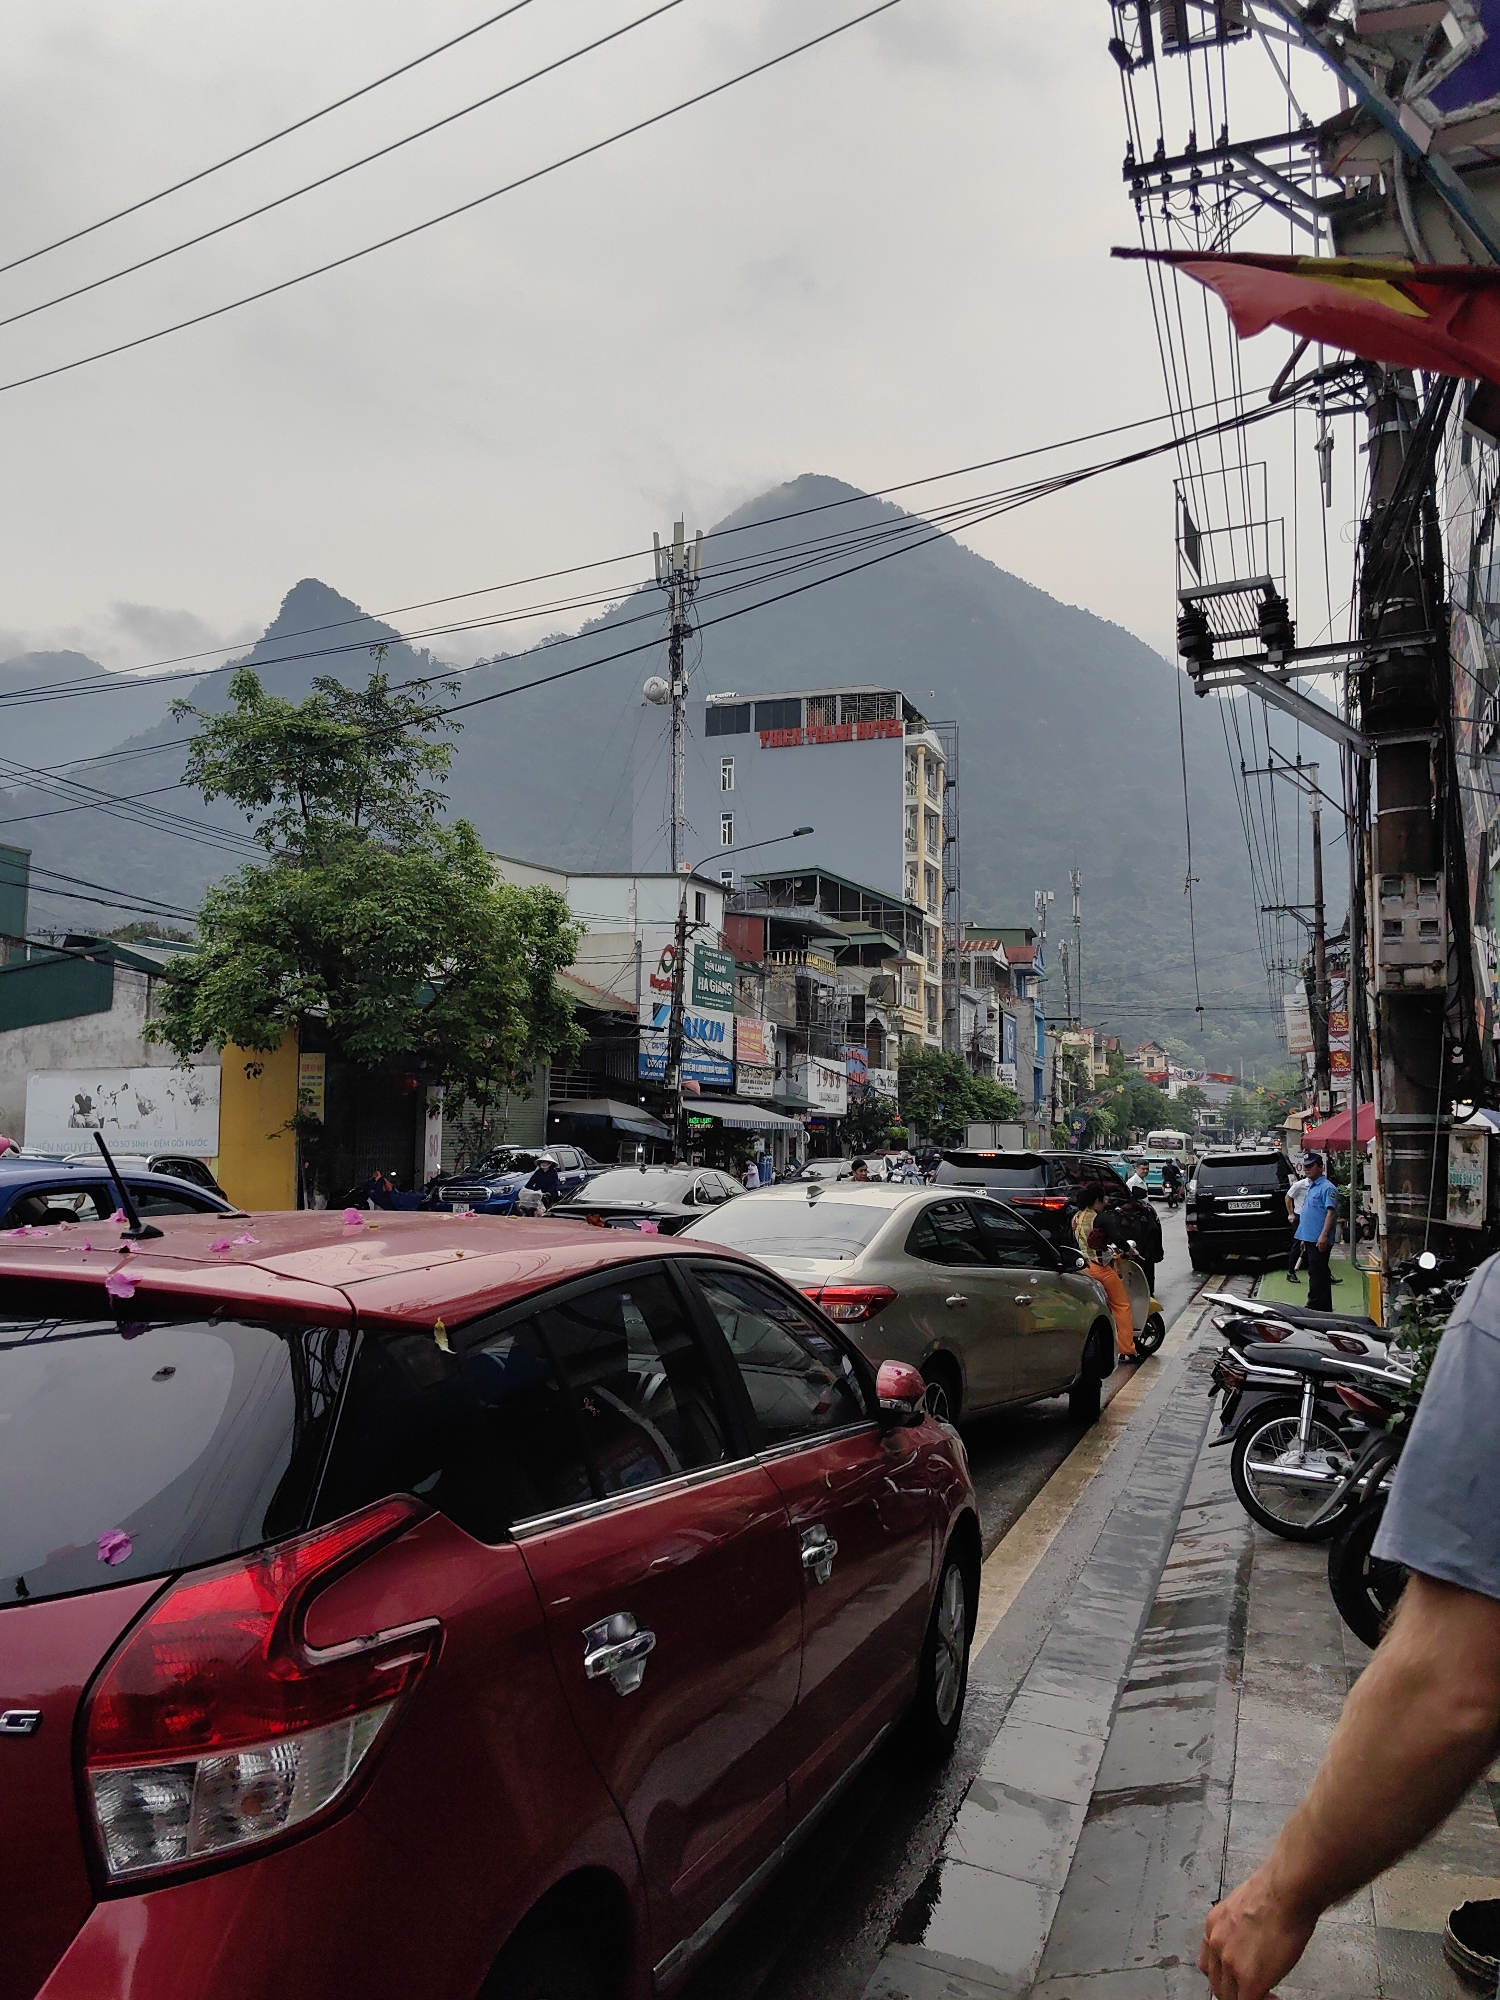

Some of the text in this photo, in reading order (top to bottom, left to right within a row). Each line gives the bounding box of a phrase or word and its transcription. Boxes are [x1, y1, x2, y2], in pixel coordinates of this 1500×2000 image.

[857, 720, 903, 740] HOTEL
[817, 1068, 840, 1089] 1988
[132, 1139, 148, 1147] SINH
